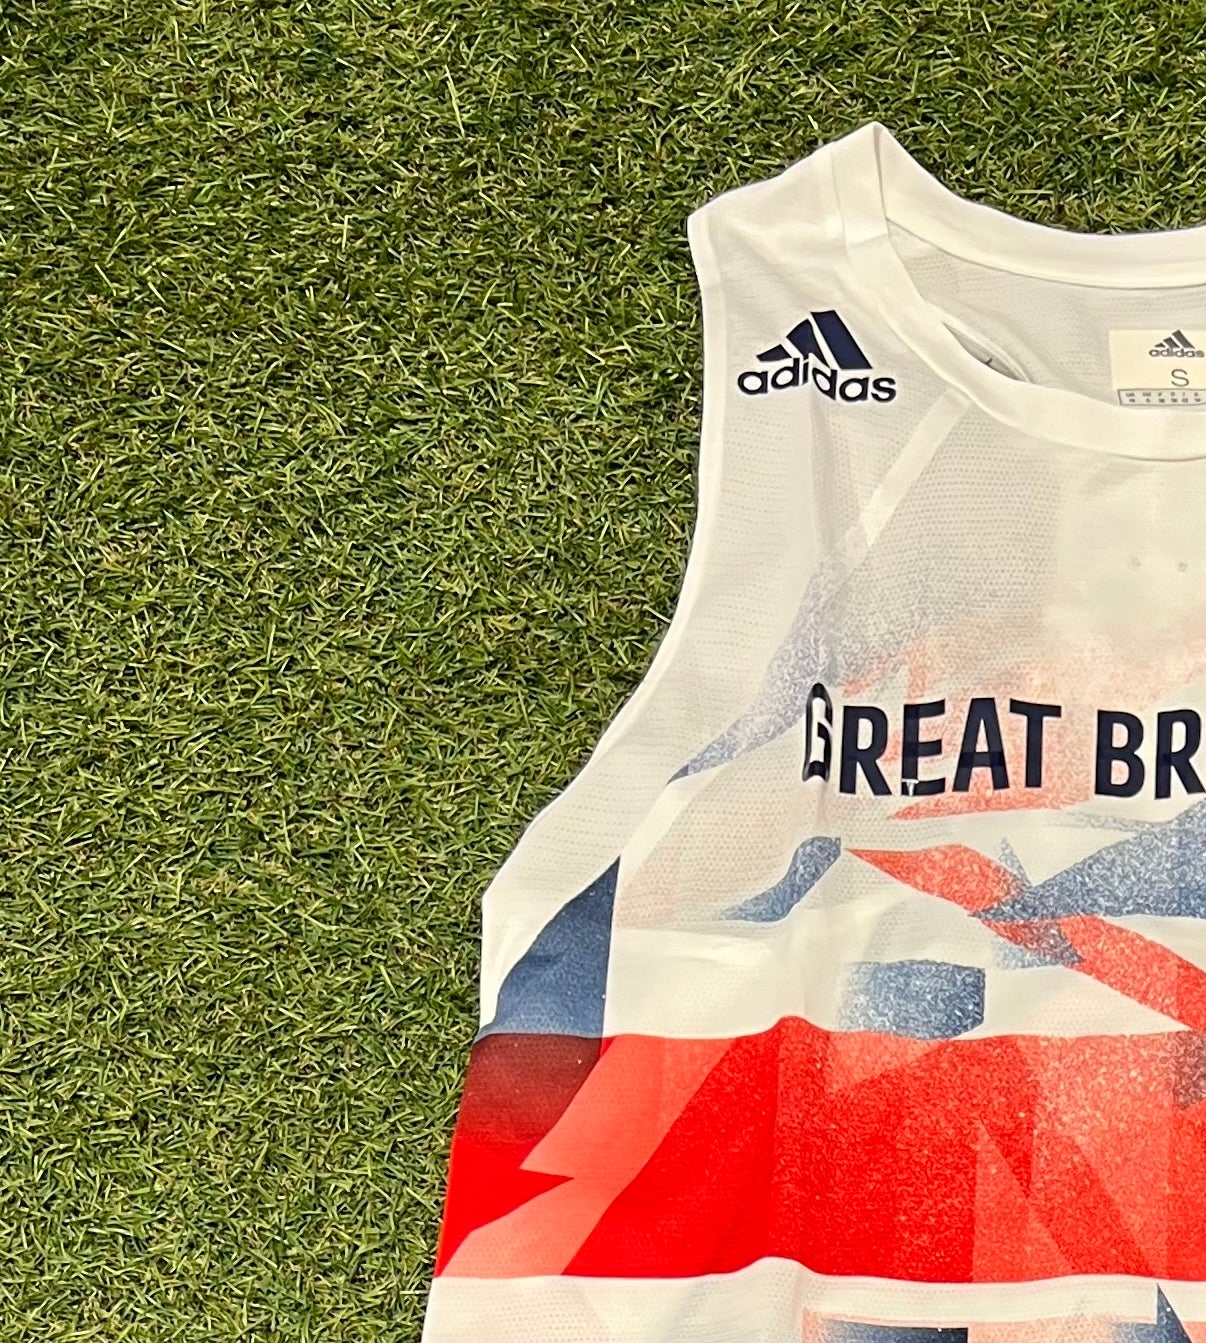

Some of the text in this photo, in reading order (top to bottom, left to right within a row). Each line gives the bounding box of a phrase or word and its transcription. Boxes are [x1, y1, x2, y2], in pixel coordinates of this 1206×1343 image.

[1149, 348, 1205, 358] adidas
[737, 355, 897, 403] adidas
[1171, 368, 1190, 387] S
[802, 682, 1062, 796] GREAT
